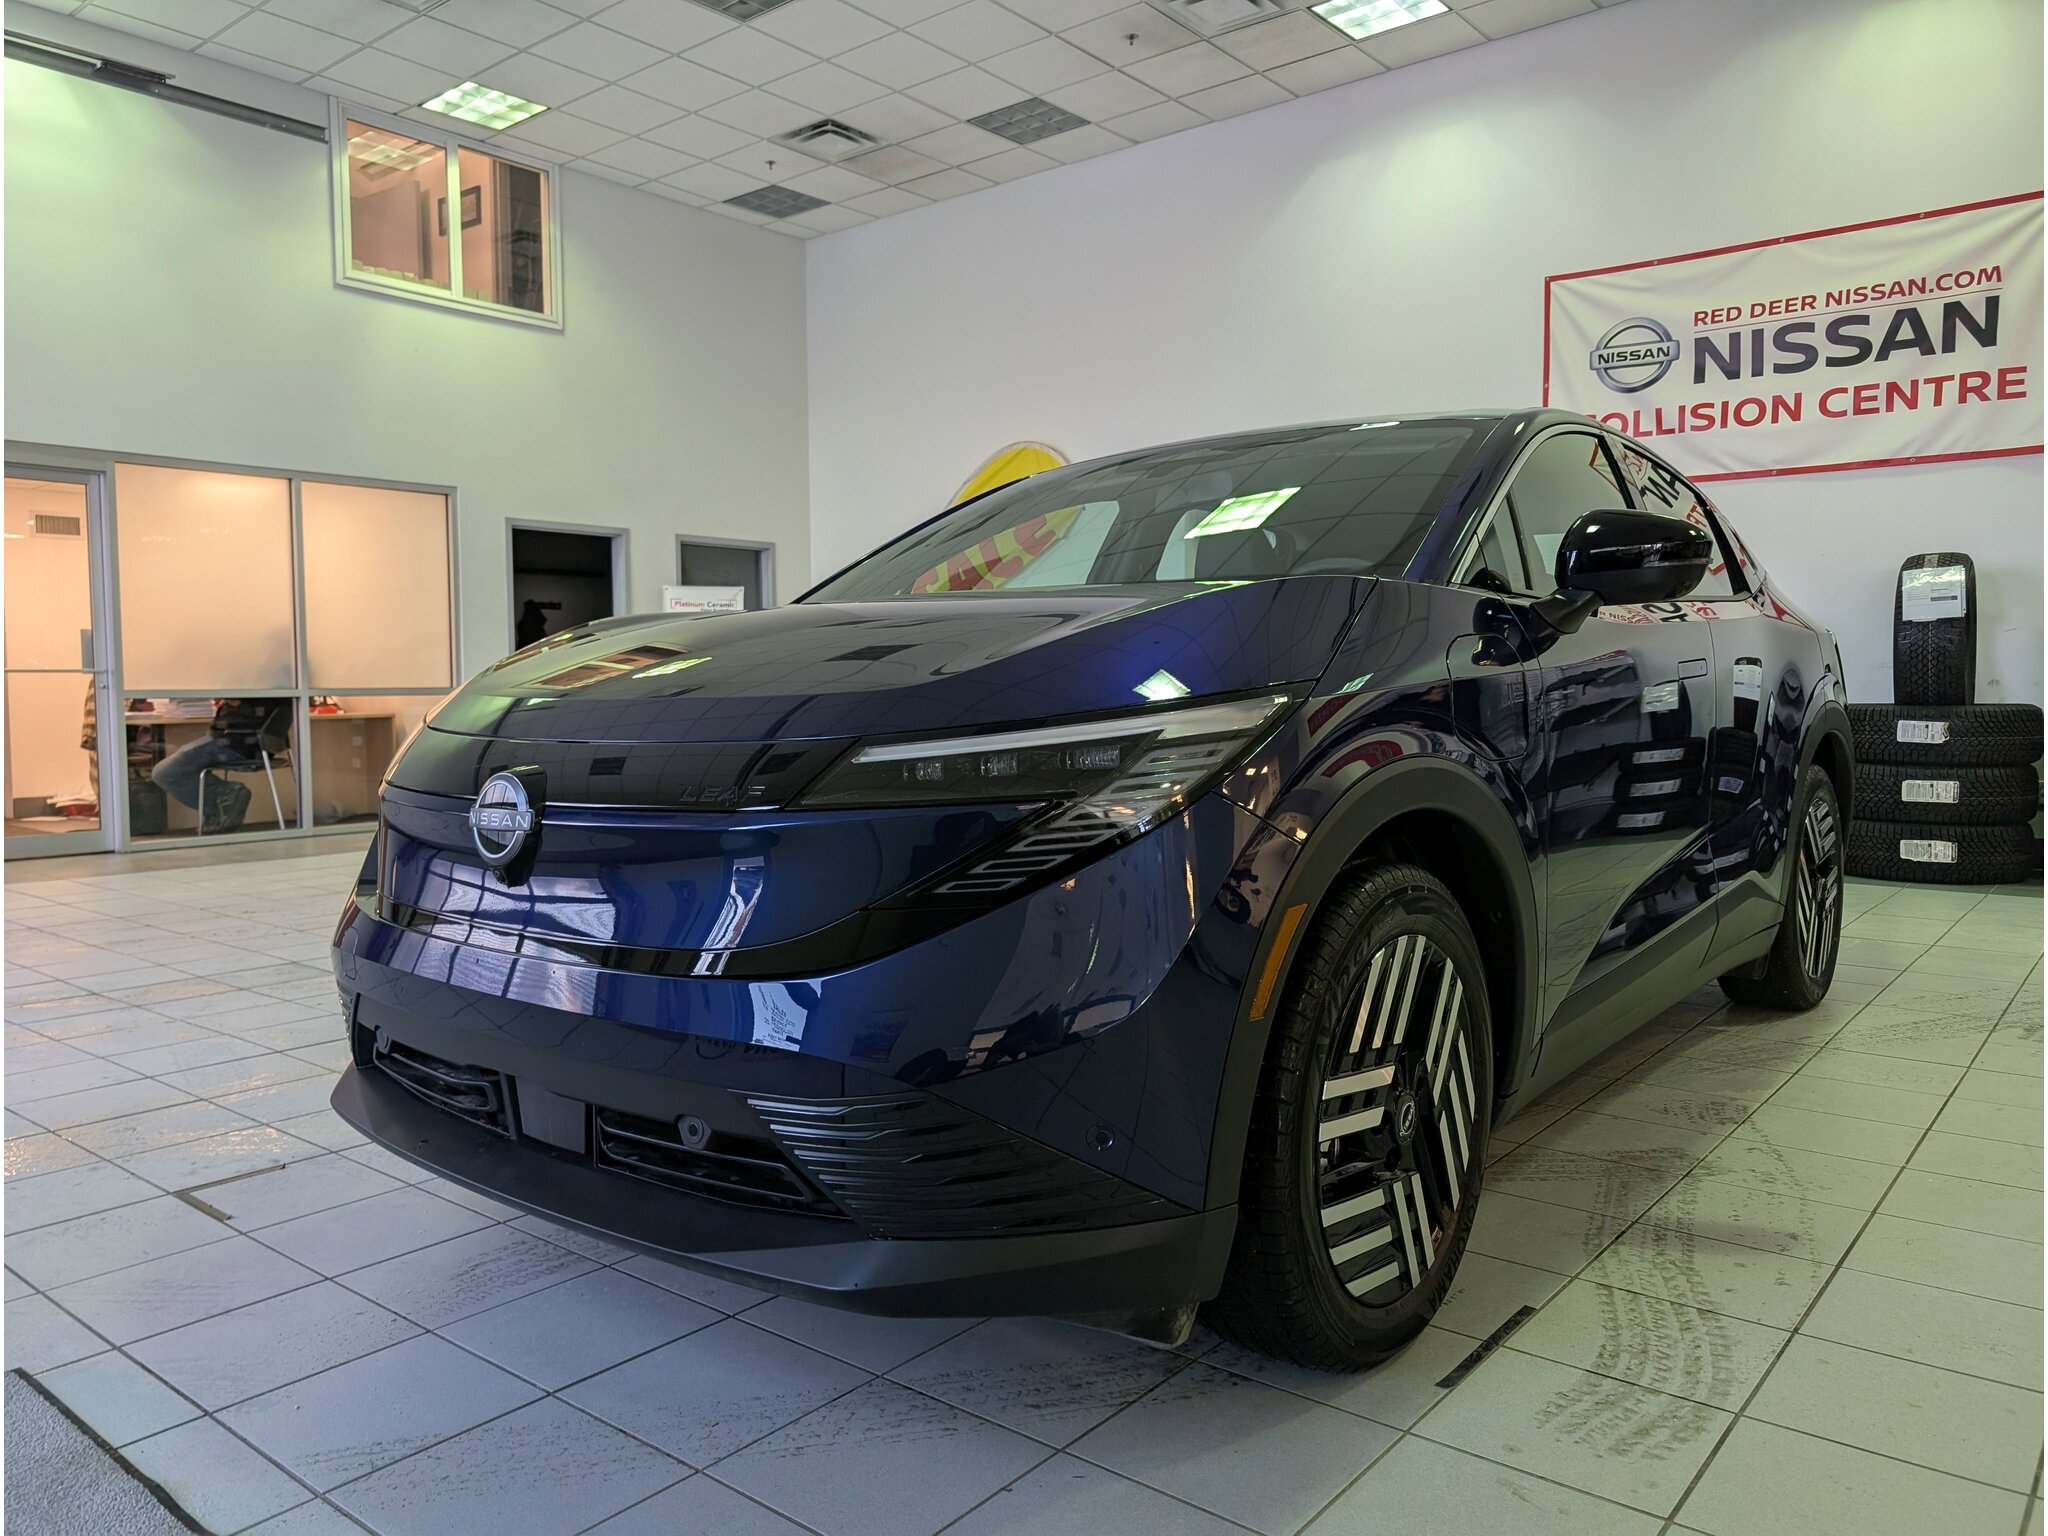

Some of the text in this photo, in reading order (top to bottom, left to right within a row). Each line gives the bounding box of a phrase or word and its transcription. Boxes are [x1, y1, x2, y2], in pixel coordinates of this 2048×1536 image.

[1693, 265, 2003, 328] RED DEER NISSAN.COM
[1693, 295, 2000, 385] NISSAN
[1598, 345, 1671, 365] NISSAN
[1818, 366, 2028, 418] CENTRE
[674, 600, 735, 609] Platinum Ceramic
[679, 784, 768, 802] LEAF
[470, 811, 529, 828] NISSAN
